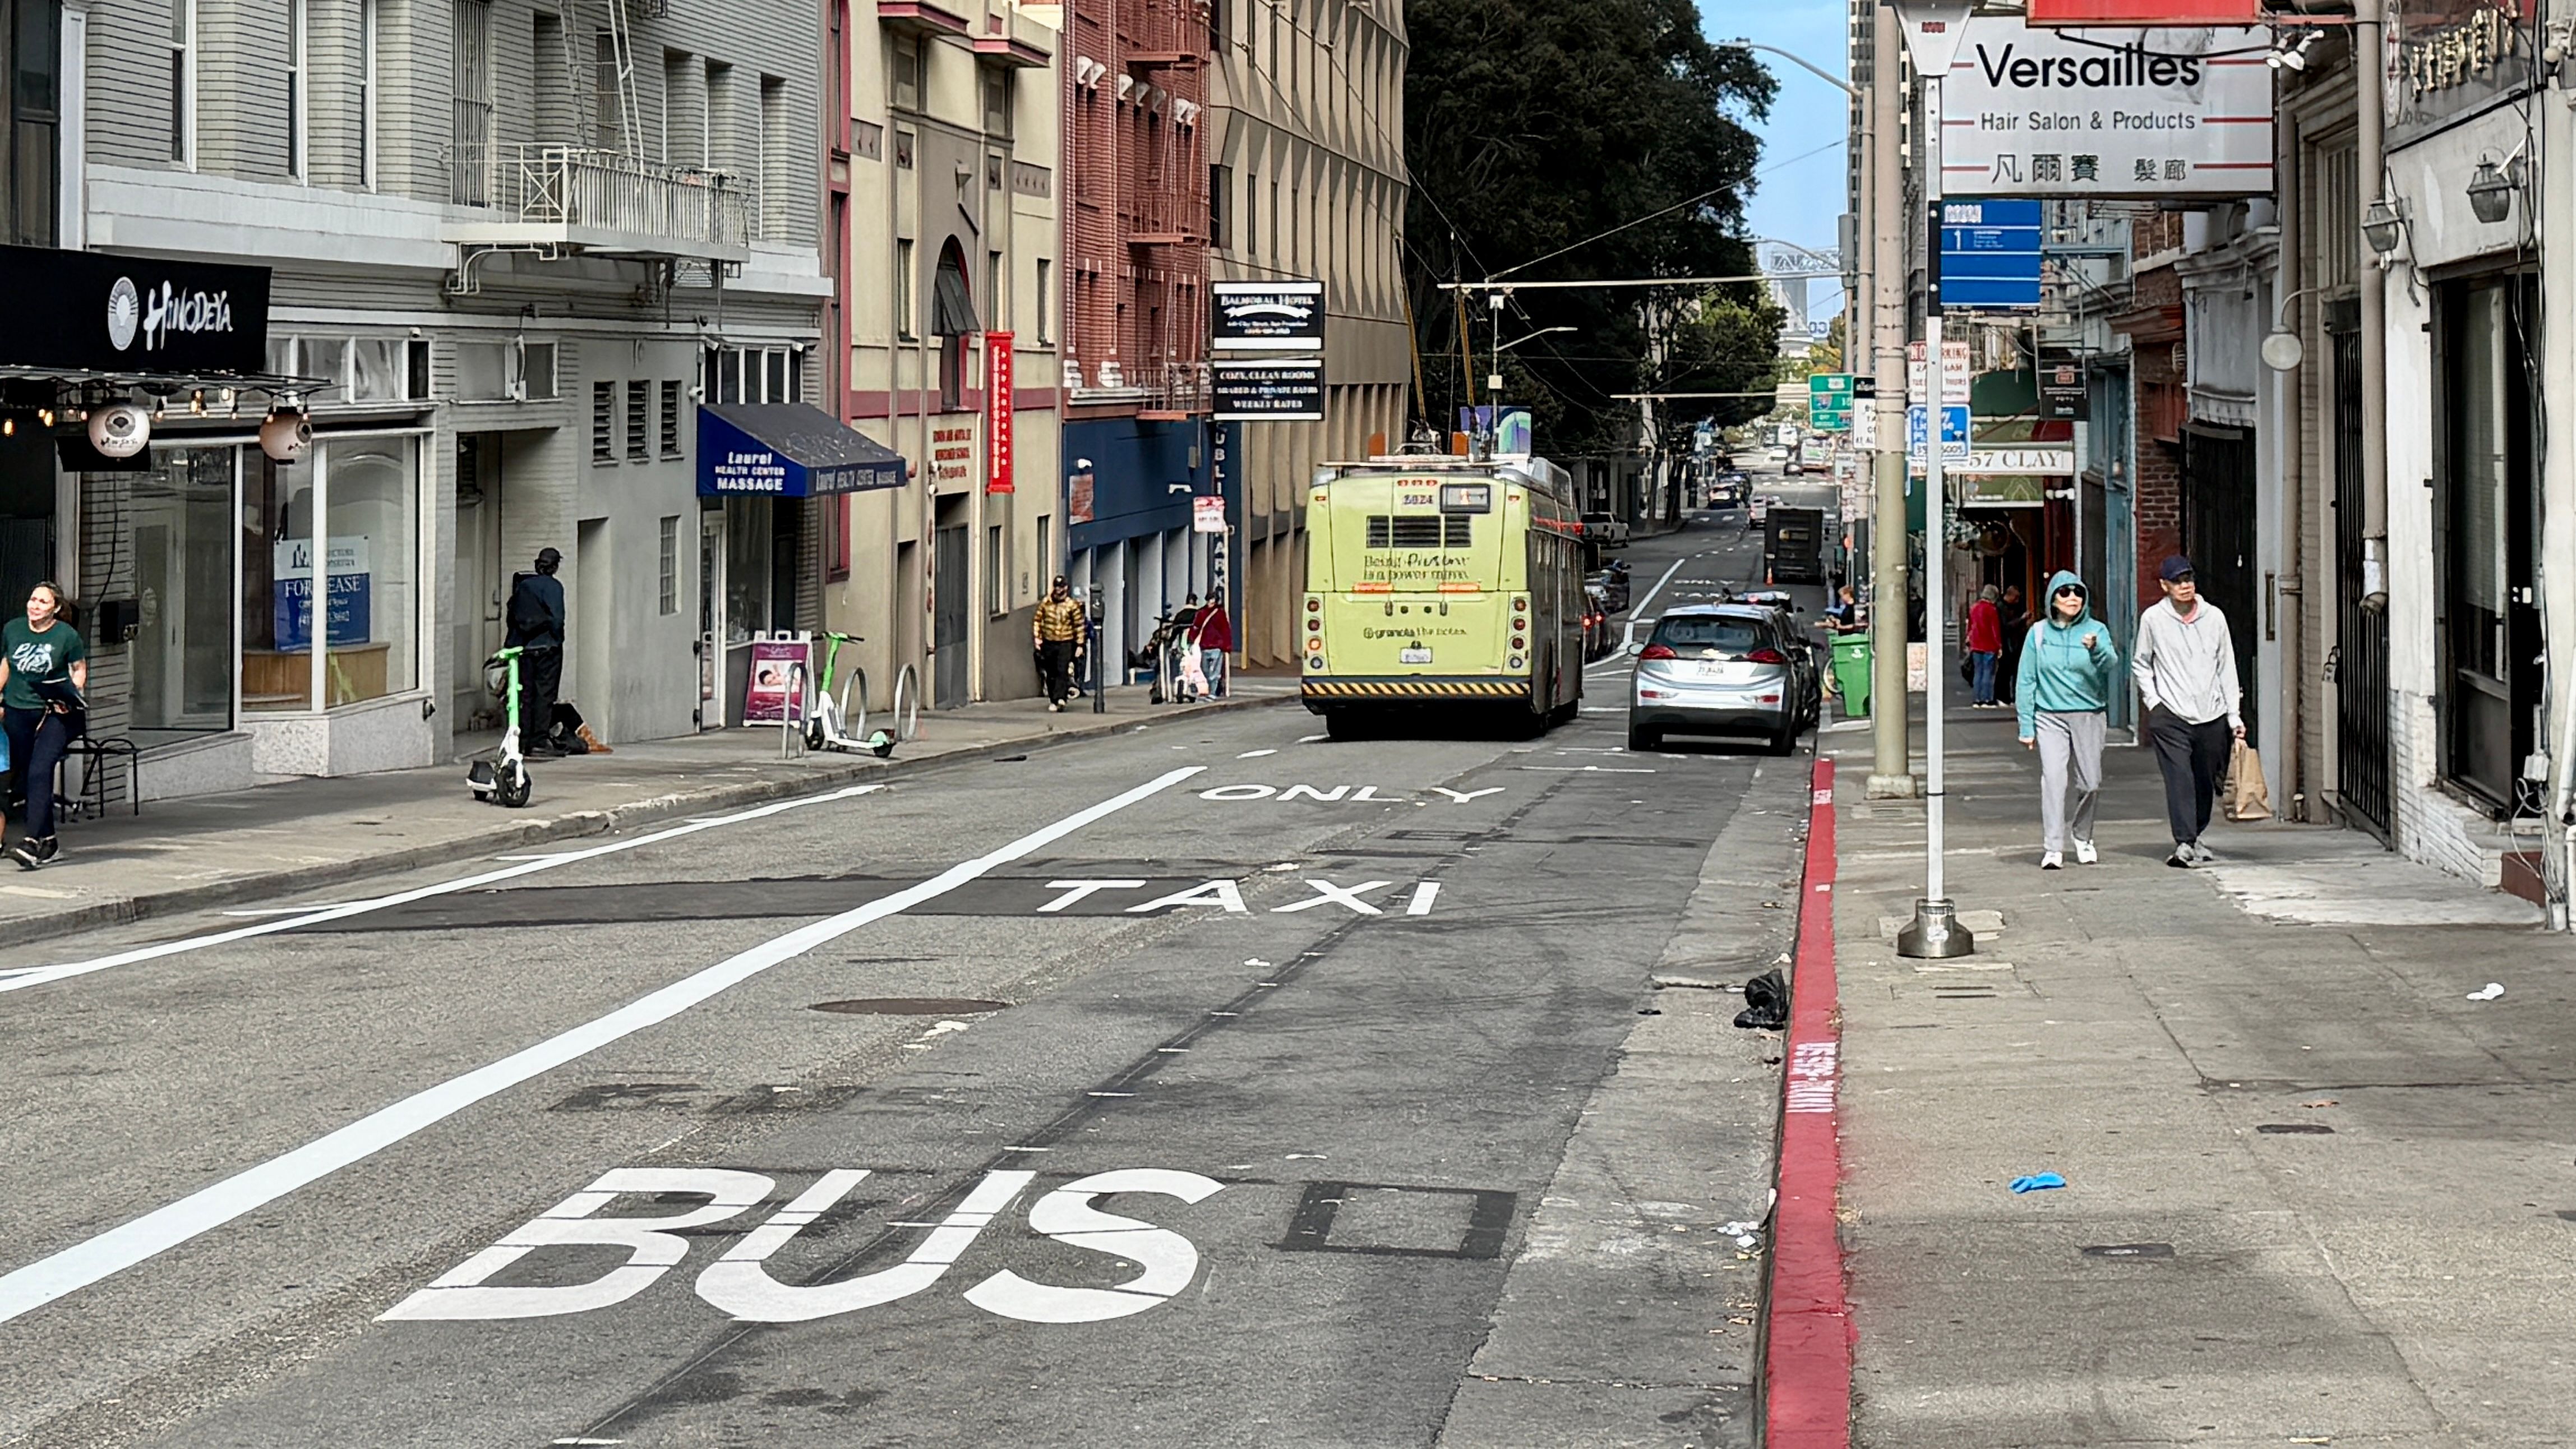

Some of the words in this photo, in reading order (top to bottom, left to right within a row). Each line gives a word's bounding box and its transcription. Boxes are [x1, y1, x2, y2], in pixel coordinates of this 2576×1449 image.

[1976, 42, 2200, 87] Versailles
[1981, 112, 2019, 131] Hair
[2029, 111, 2081, 131] Salon
[2090, 111, 2103, 130] &
[2113, 110, 2195, 130] Products
[728, 451, 772, 464] Laurel
[2002, 451, 2060, 468] CLAY
[717, 477, 783, 491] MASSAGE
[328, 576, 361, 594] EASE
[1199, 785, 1506, 803] ONLY
[1036, 879, 1441, 915] TAXI
[373, 1167, 1227, 1323] BUS
